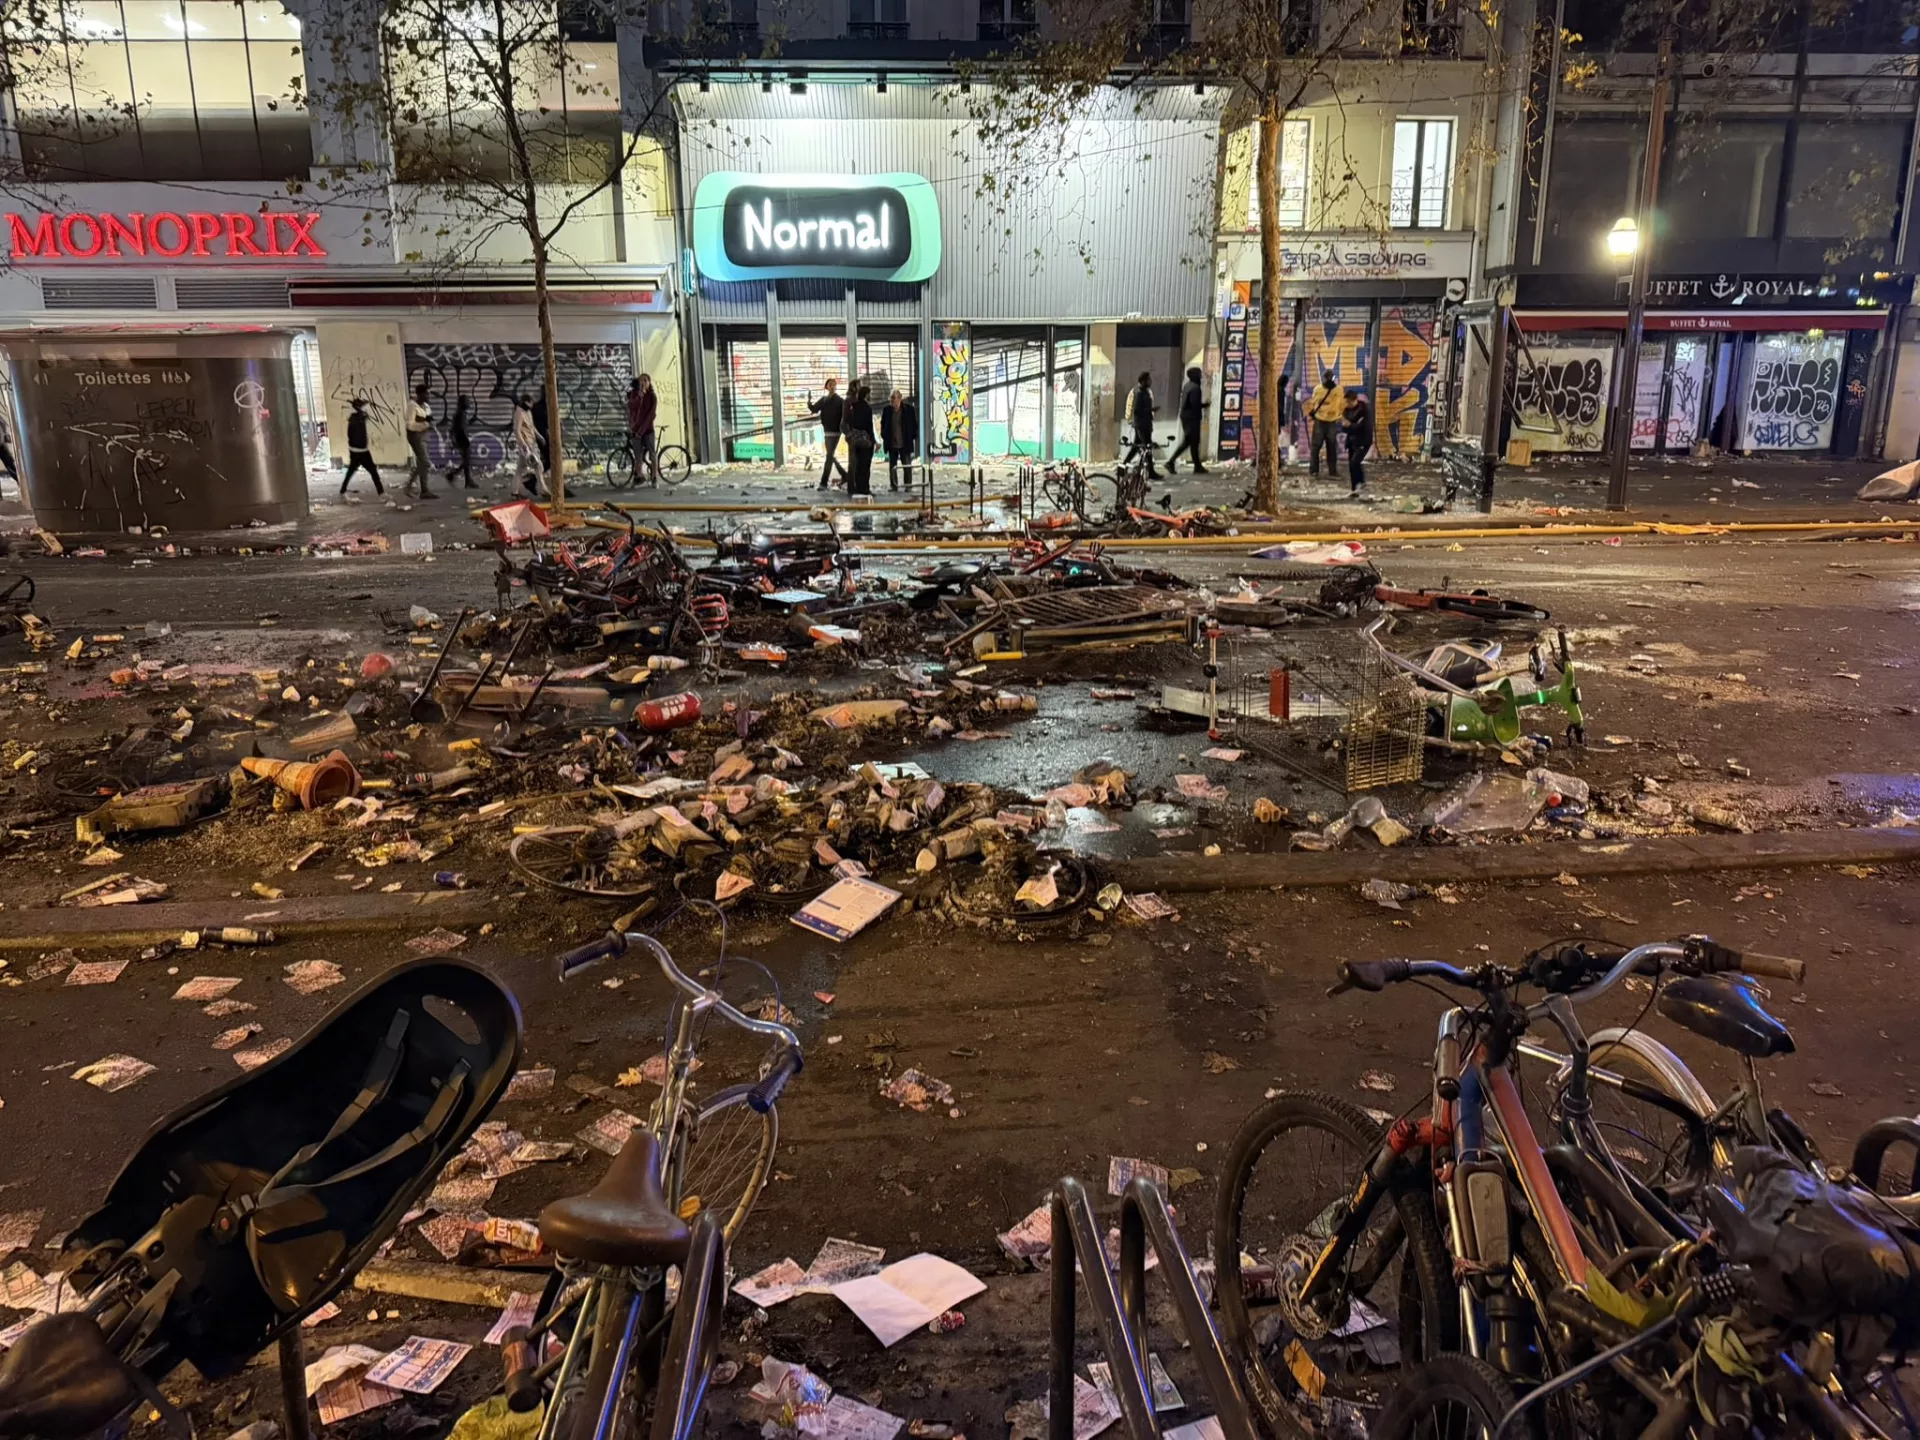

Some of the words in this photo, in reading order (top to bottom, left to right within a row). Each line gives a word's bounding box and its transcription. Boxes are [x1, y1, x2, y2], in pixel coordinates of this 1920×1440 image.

[744, 196, 889, 251] Normal
[4, 211, 328, 258] MONOPRIX
[1284, 245, 1427, 268] STRASBOURG
[1627, 280, 1702, 297] UFFET
[1670, 319, 1697, 328] BUFFET
[1709, 320, 1732, 328] ROYAL
[75, 371, 152, 386] Toilettes
